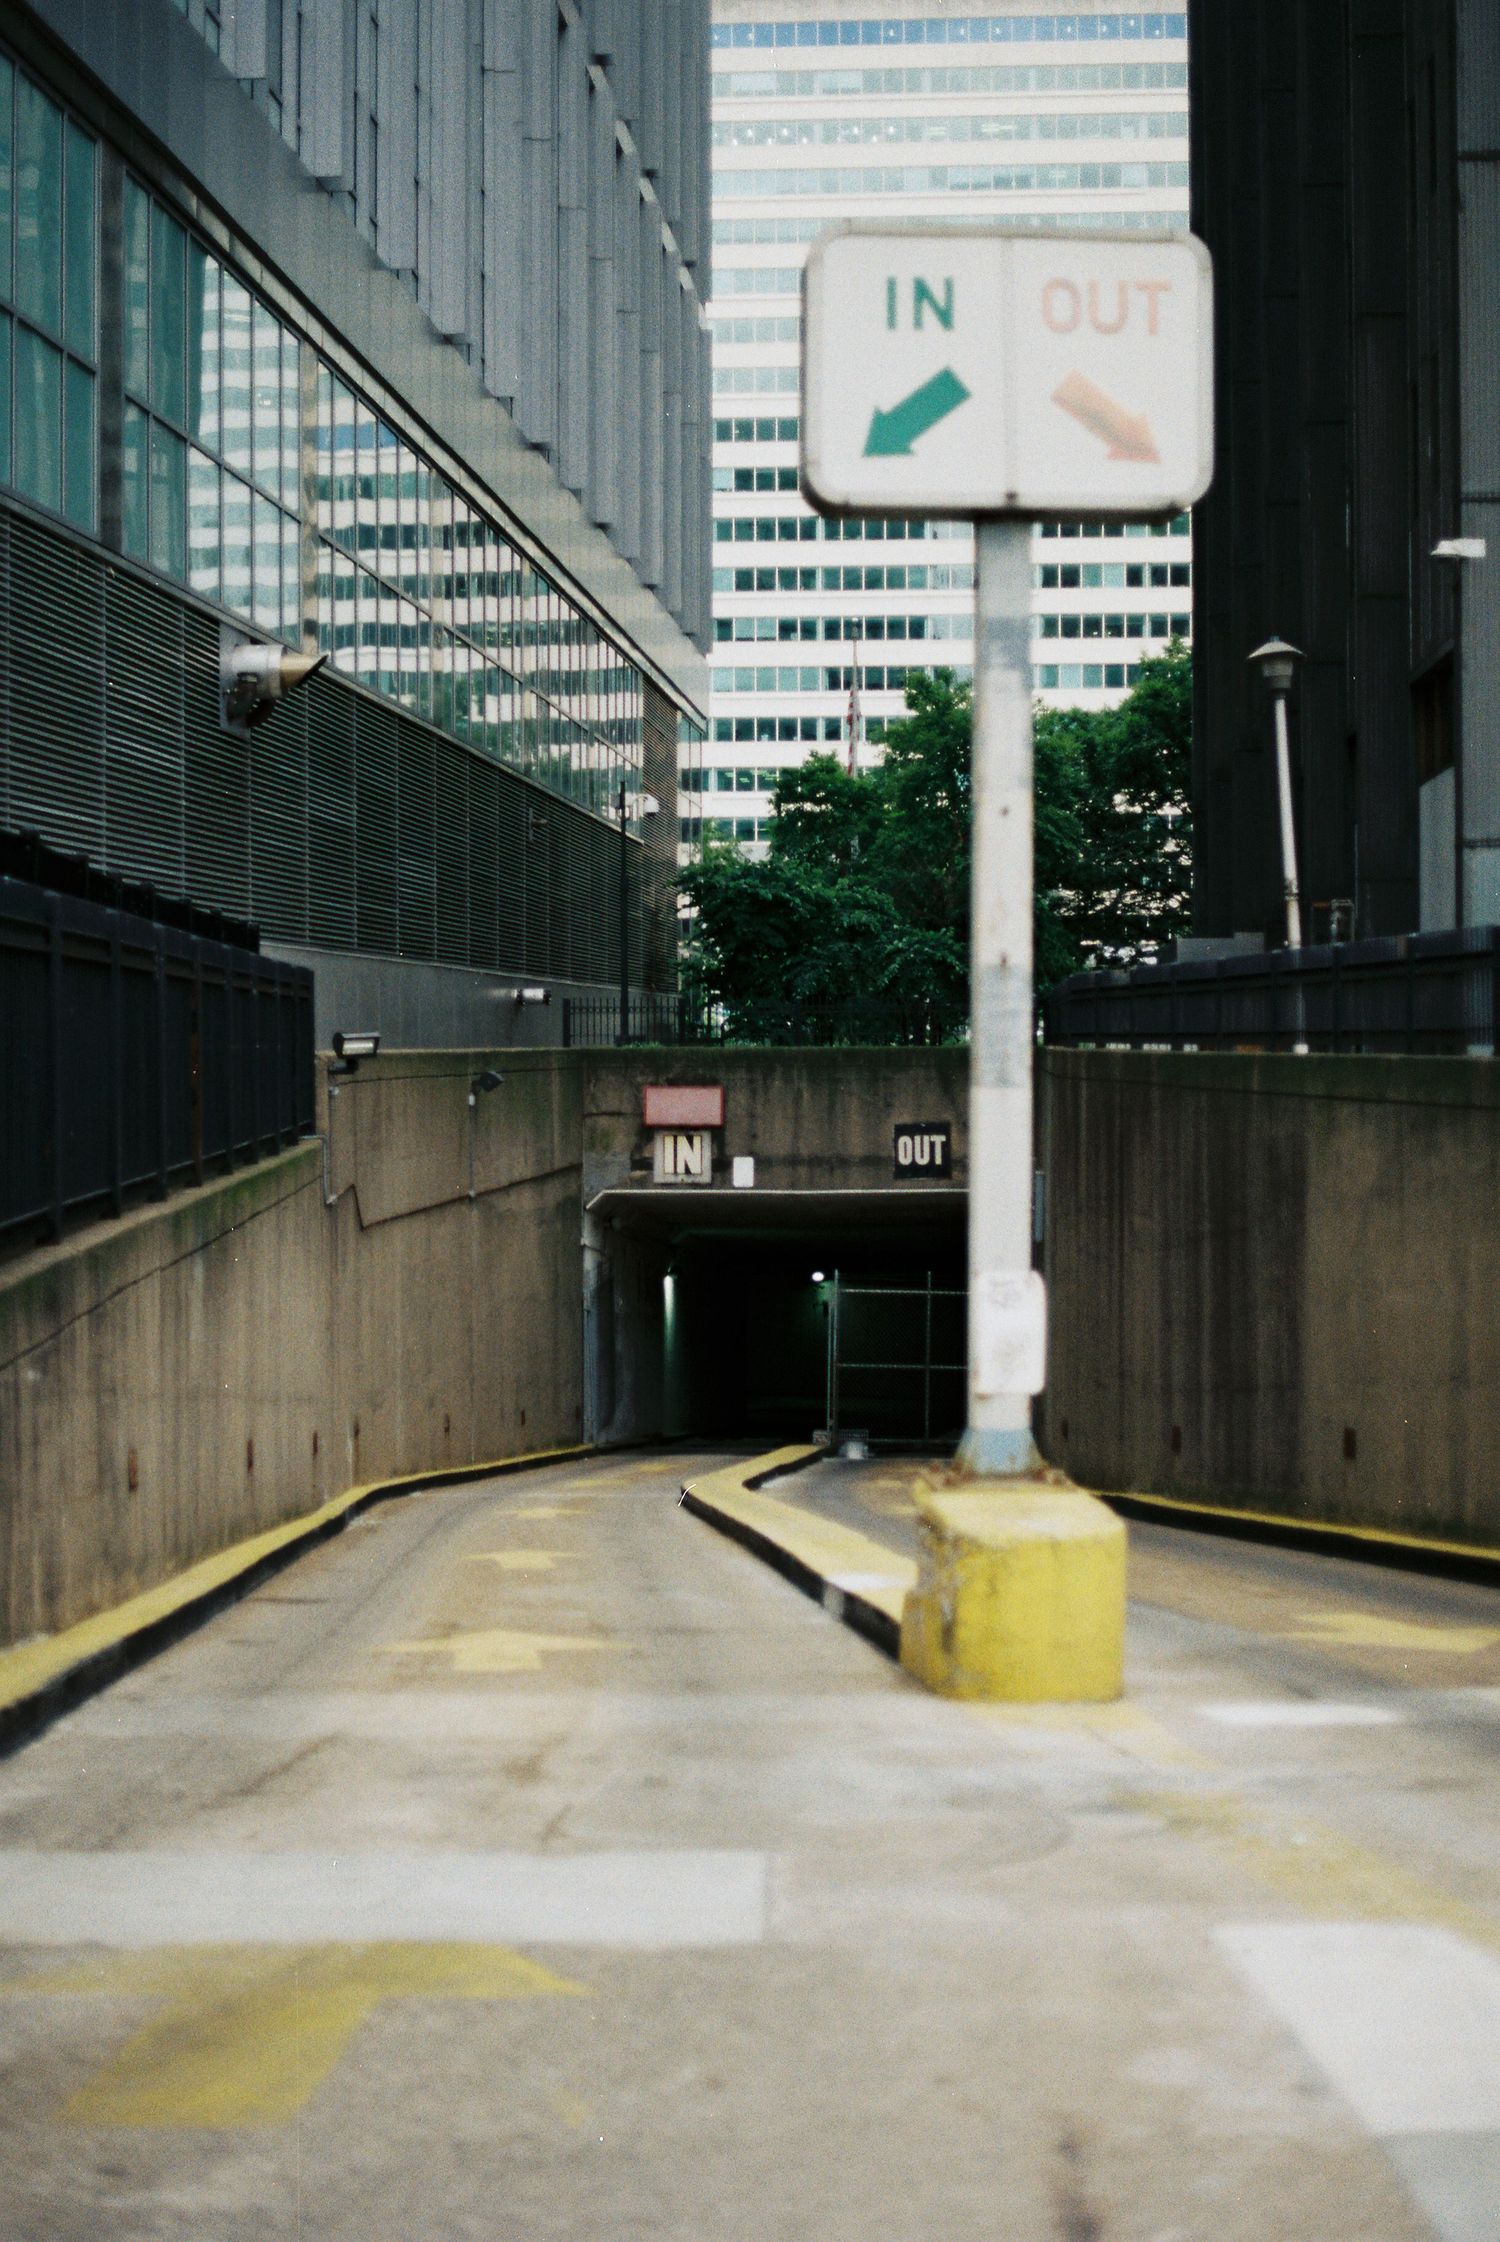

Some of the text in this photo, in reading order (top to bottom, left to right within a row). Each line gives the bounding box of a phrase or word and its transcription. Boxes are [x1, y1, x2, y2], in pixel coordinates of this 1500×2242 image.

[886, 276, 954, 331] IN
[1041, 277, 1172, 336] OUT
[663, 1134, 702, 1175] IN
[898, 1135, 946, 1166] OUT
